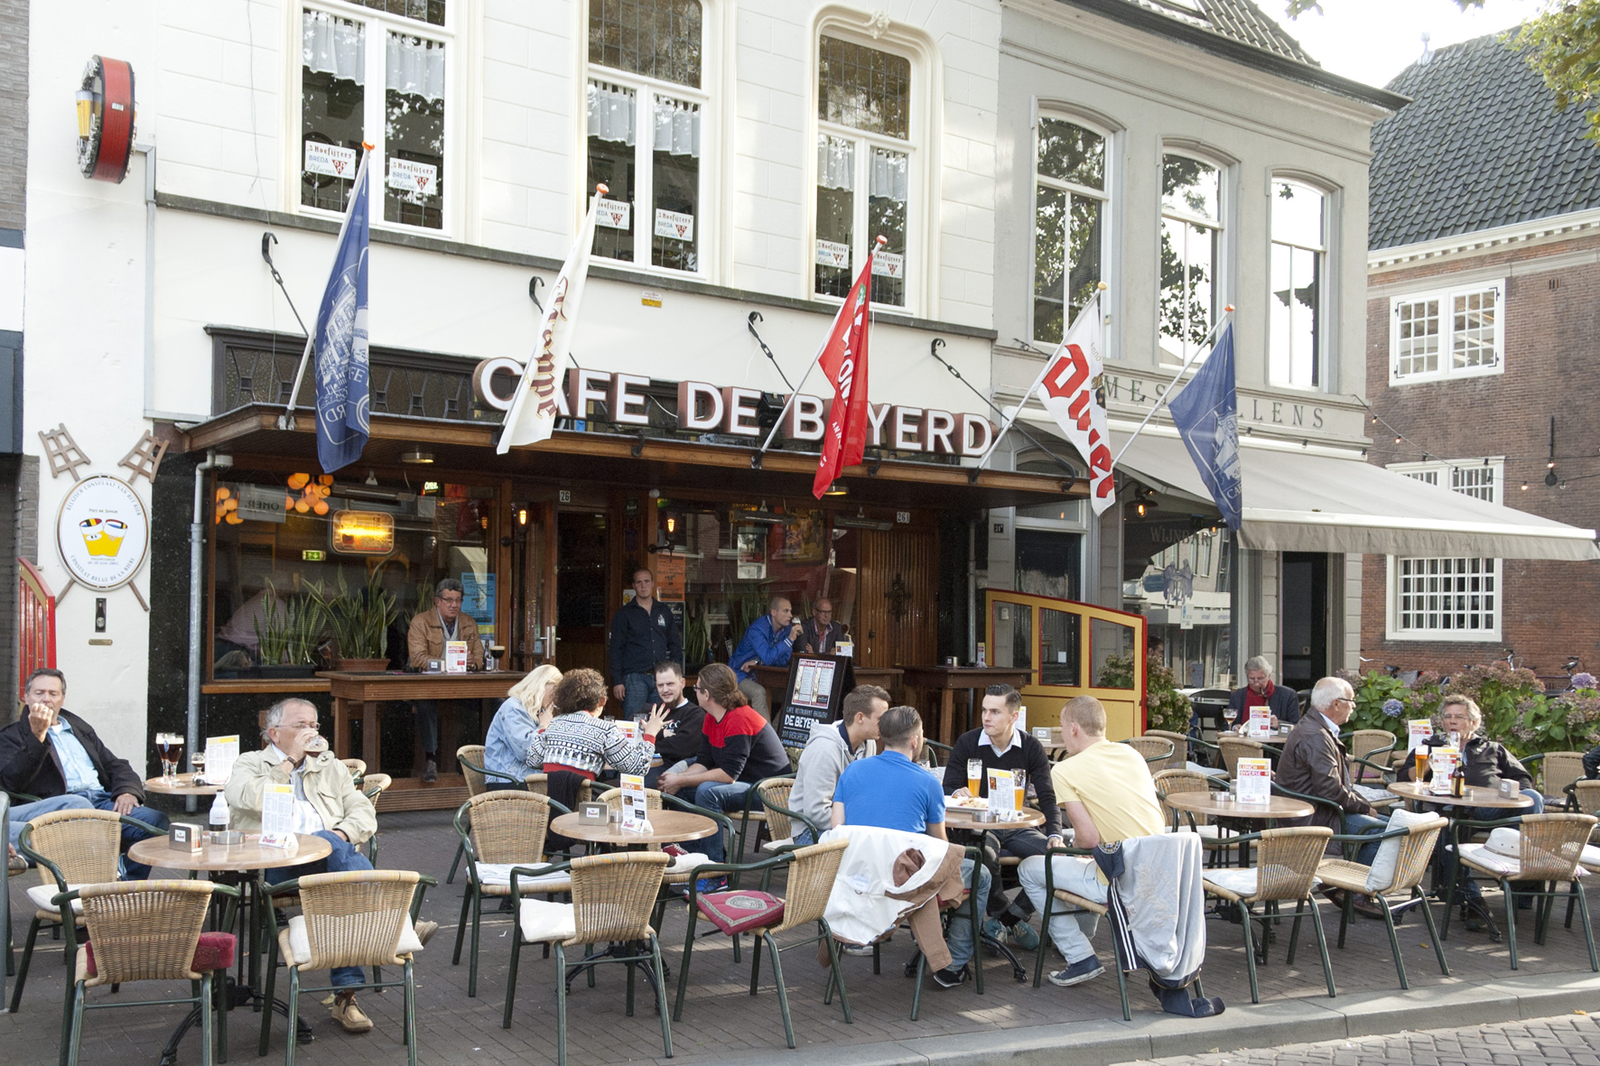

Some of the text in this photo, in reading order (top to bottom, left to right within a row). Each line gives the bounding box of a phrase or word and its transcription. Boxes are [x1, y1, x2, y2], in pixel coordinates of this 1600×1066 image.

[308, 154, 329, 164] BREDA
[392, 171, 412, 180] BREDA
[596, 209, 609, 217] REDA
[657, 220, 673, 229] BREDA
[1103, 375, 1168, 408] MES
[678, 380, 763, 436] DE
[784, 393, 999, 457] BYERD
[83, 481, 116, 490] CONSULAAT
[117, 484, 128, 495] VAN
[561, 491, 570, 501] 26
[784, 714, 795, 726] DE
